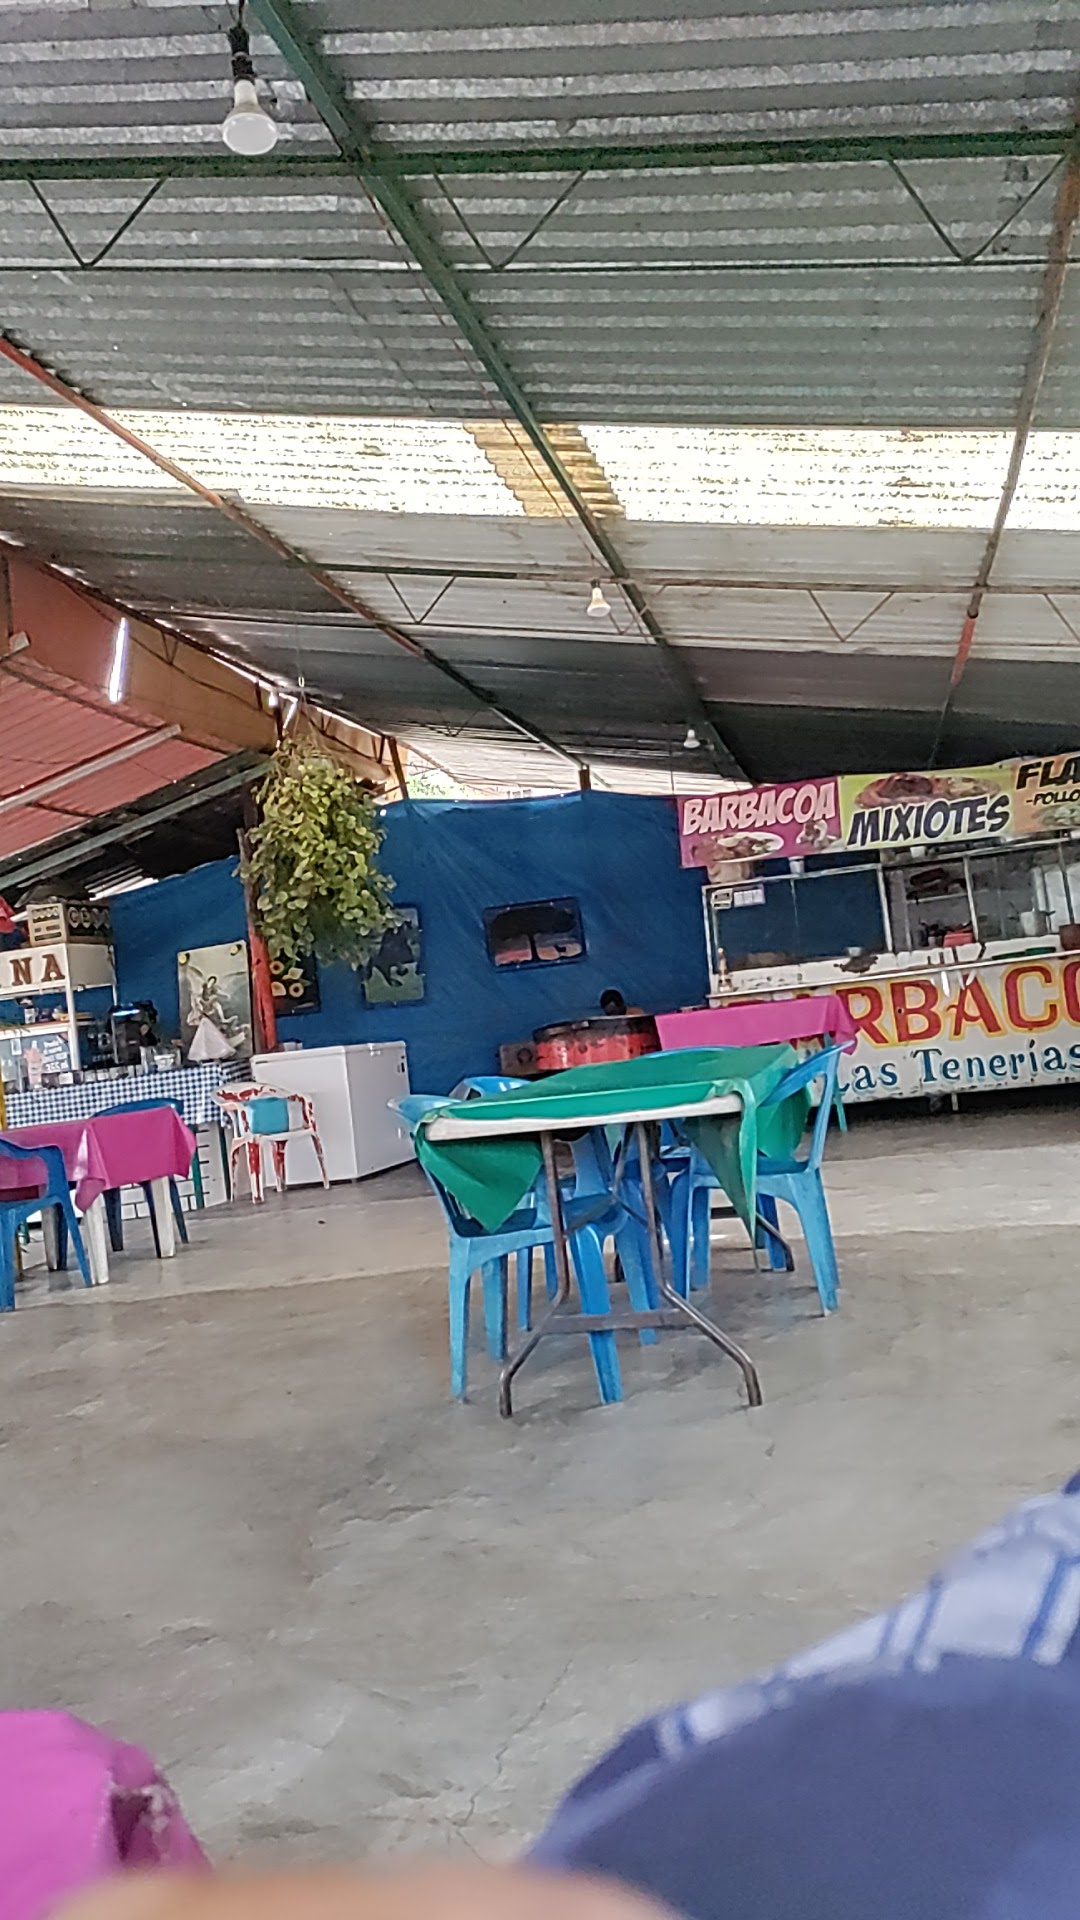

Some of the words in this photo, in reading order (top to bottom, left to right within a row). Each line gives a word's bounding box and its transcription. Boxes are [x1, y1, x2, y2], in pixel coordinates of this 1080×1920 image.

[682, 781, 837, 836] BARBACOA
[847, 794, 1011, 847] MIXIOTES
[0, 952, 66, 987] NA
